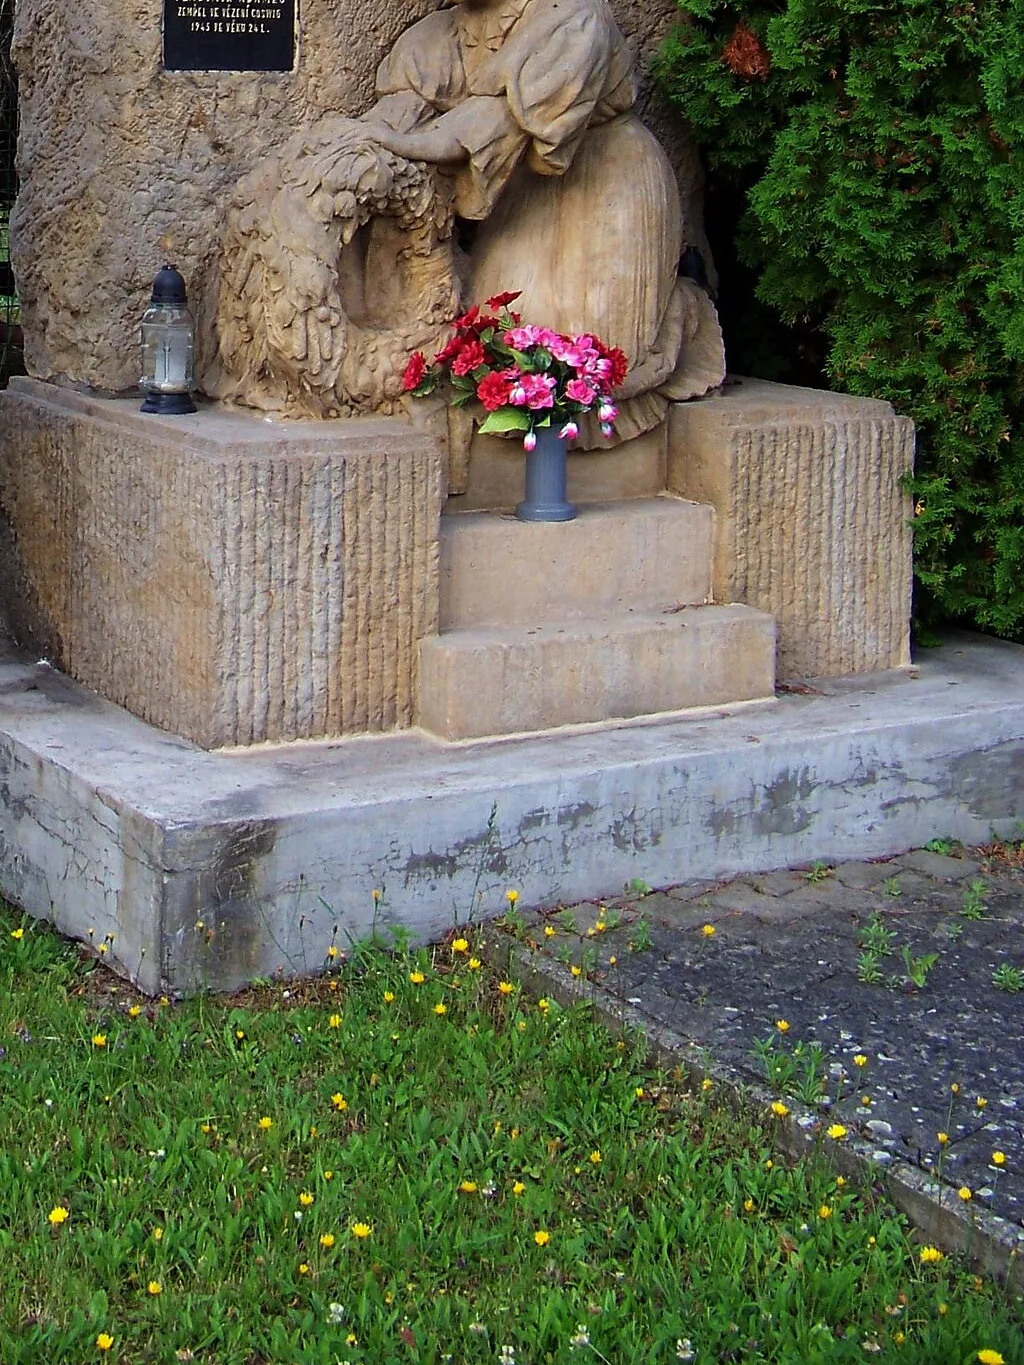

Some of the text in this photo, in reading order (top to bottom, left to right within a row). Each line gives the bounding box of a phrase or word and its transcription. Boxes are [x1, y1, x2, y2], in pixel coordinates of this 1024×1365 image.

[178, 4, 281, 18] ZEMŘEL VE VĚZENÍ COSWIG
[191, 20, 270, 33] 1945 VE VĚKU 24 L.
